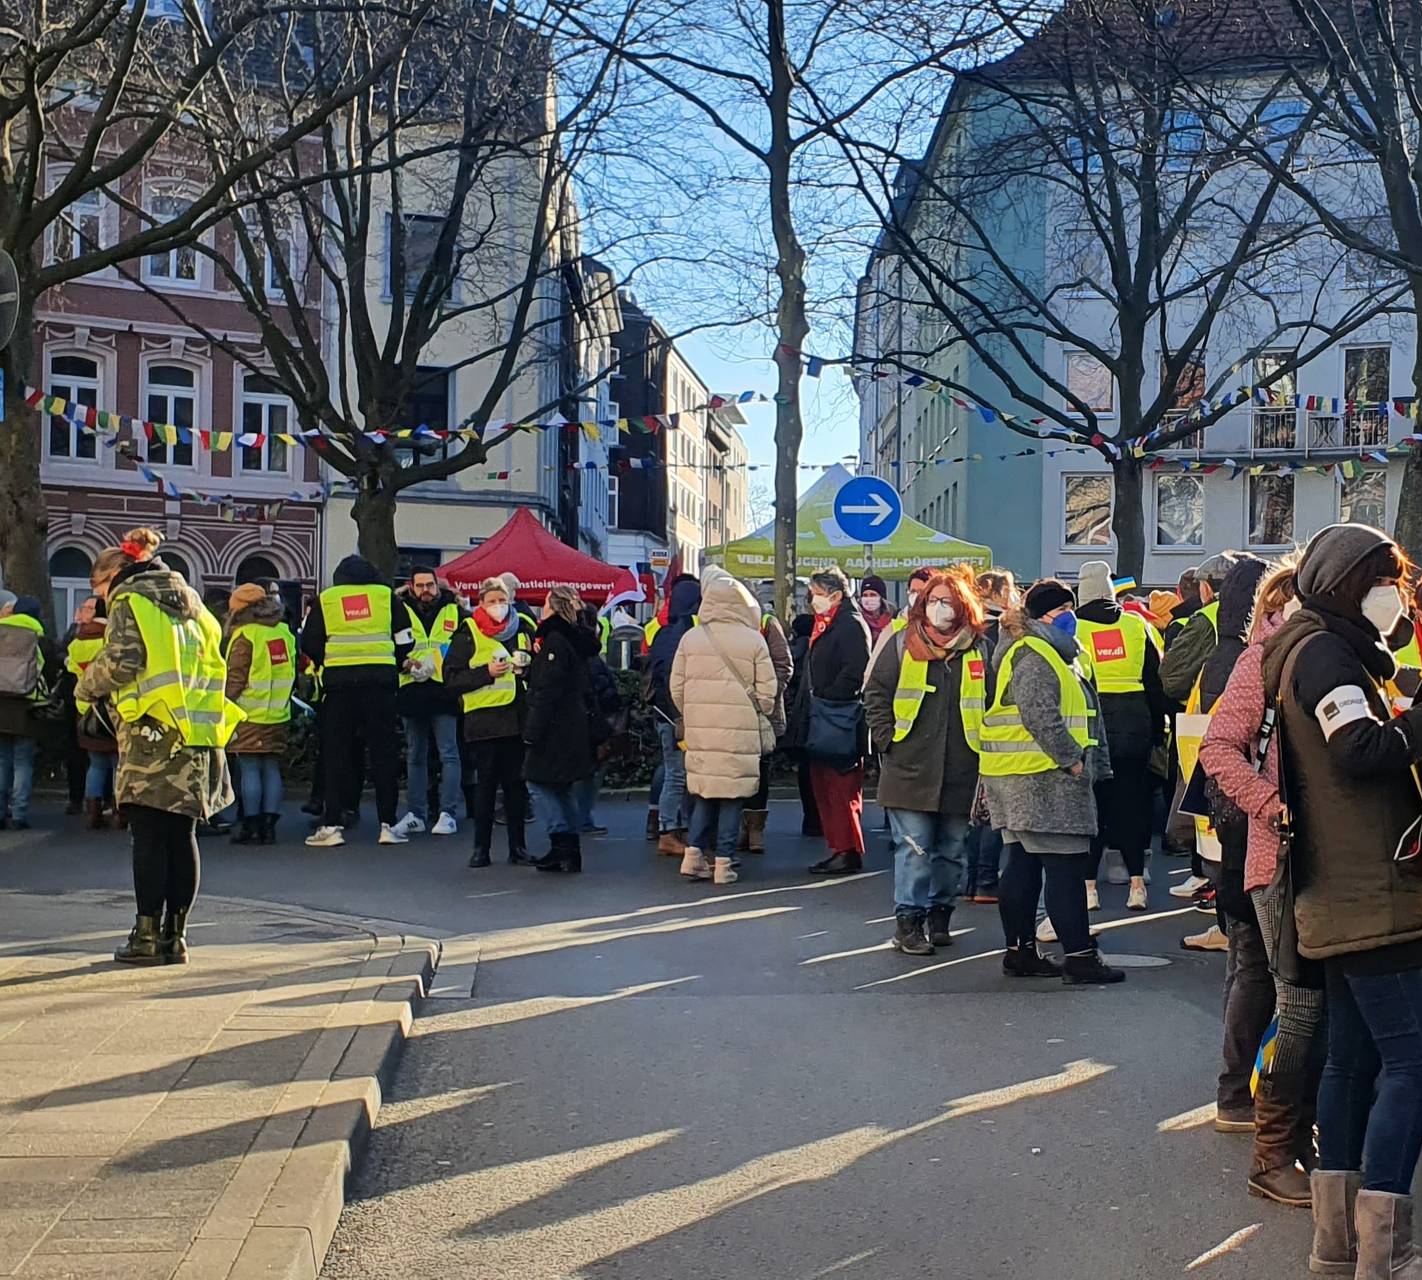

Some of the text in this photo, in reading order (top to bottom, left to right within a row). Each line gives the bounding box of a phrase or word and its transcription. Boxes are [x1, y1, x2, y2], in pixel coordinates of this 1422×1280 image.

[736, 554, 776, 565] VER.D
[454, 581, 482, 591] Verei
[1096, 646, 1124, 656] ver.di
